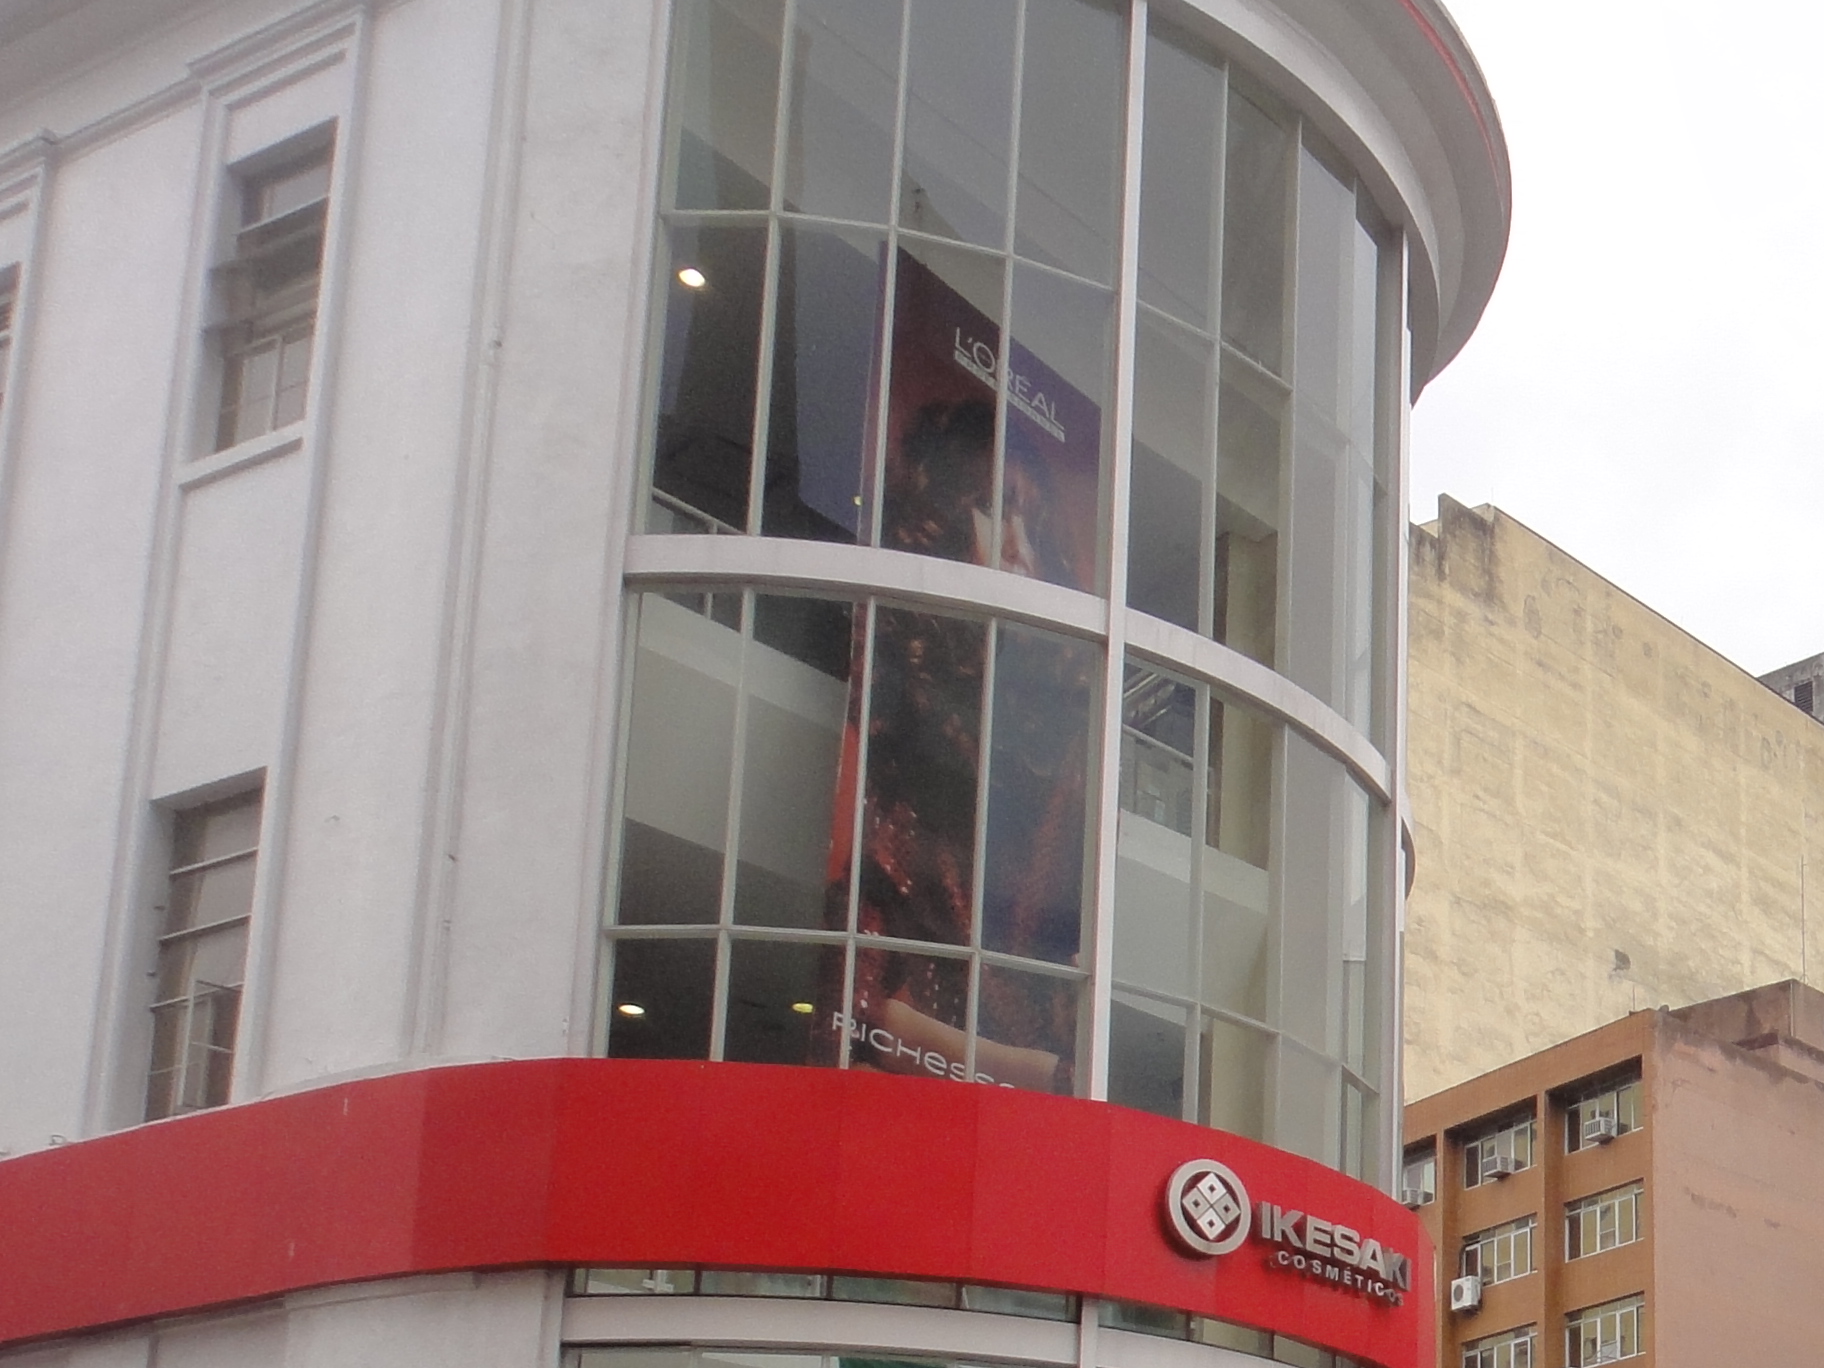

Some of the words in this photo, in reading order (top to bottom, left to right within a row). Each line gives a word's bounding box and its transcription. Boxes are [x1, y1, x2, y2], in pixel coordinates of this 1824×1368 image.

[832, 1011, 1017, 1089] RICHes
[1259, 1200, 1412, 1292] IKESAKI
[1276, 1249, 1404, 1307] COSMÉTICOS
